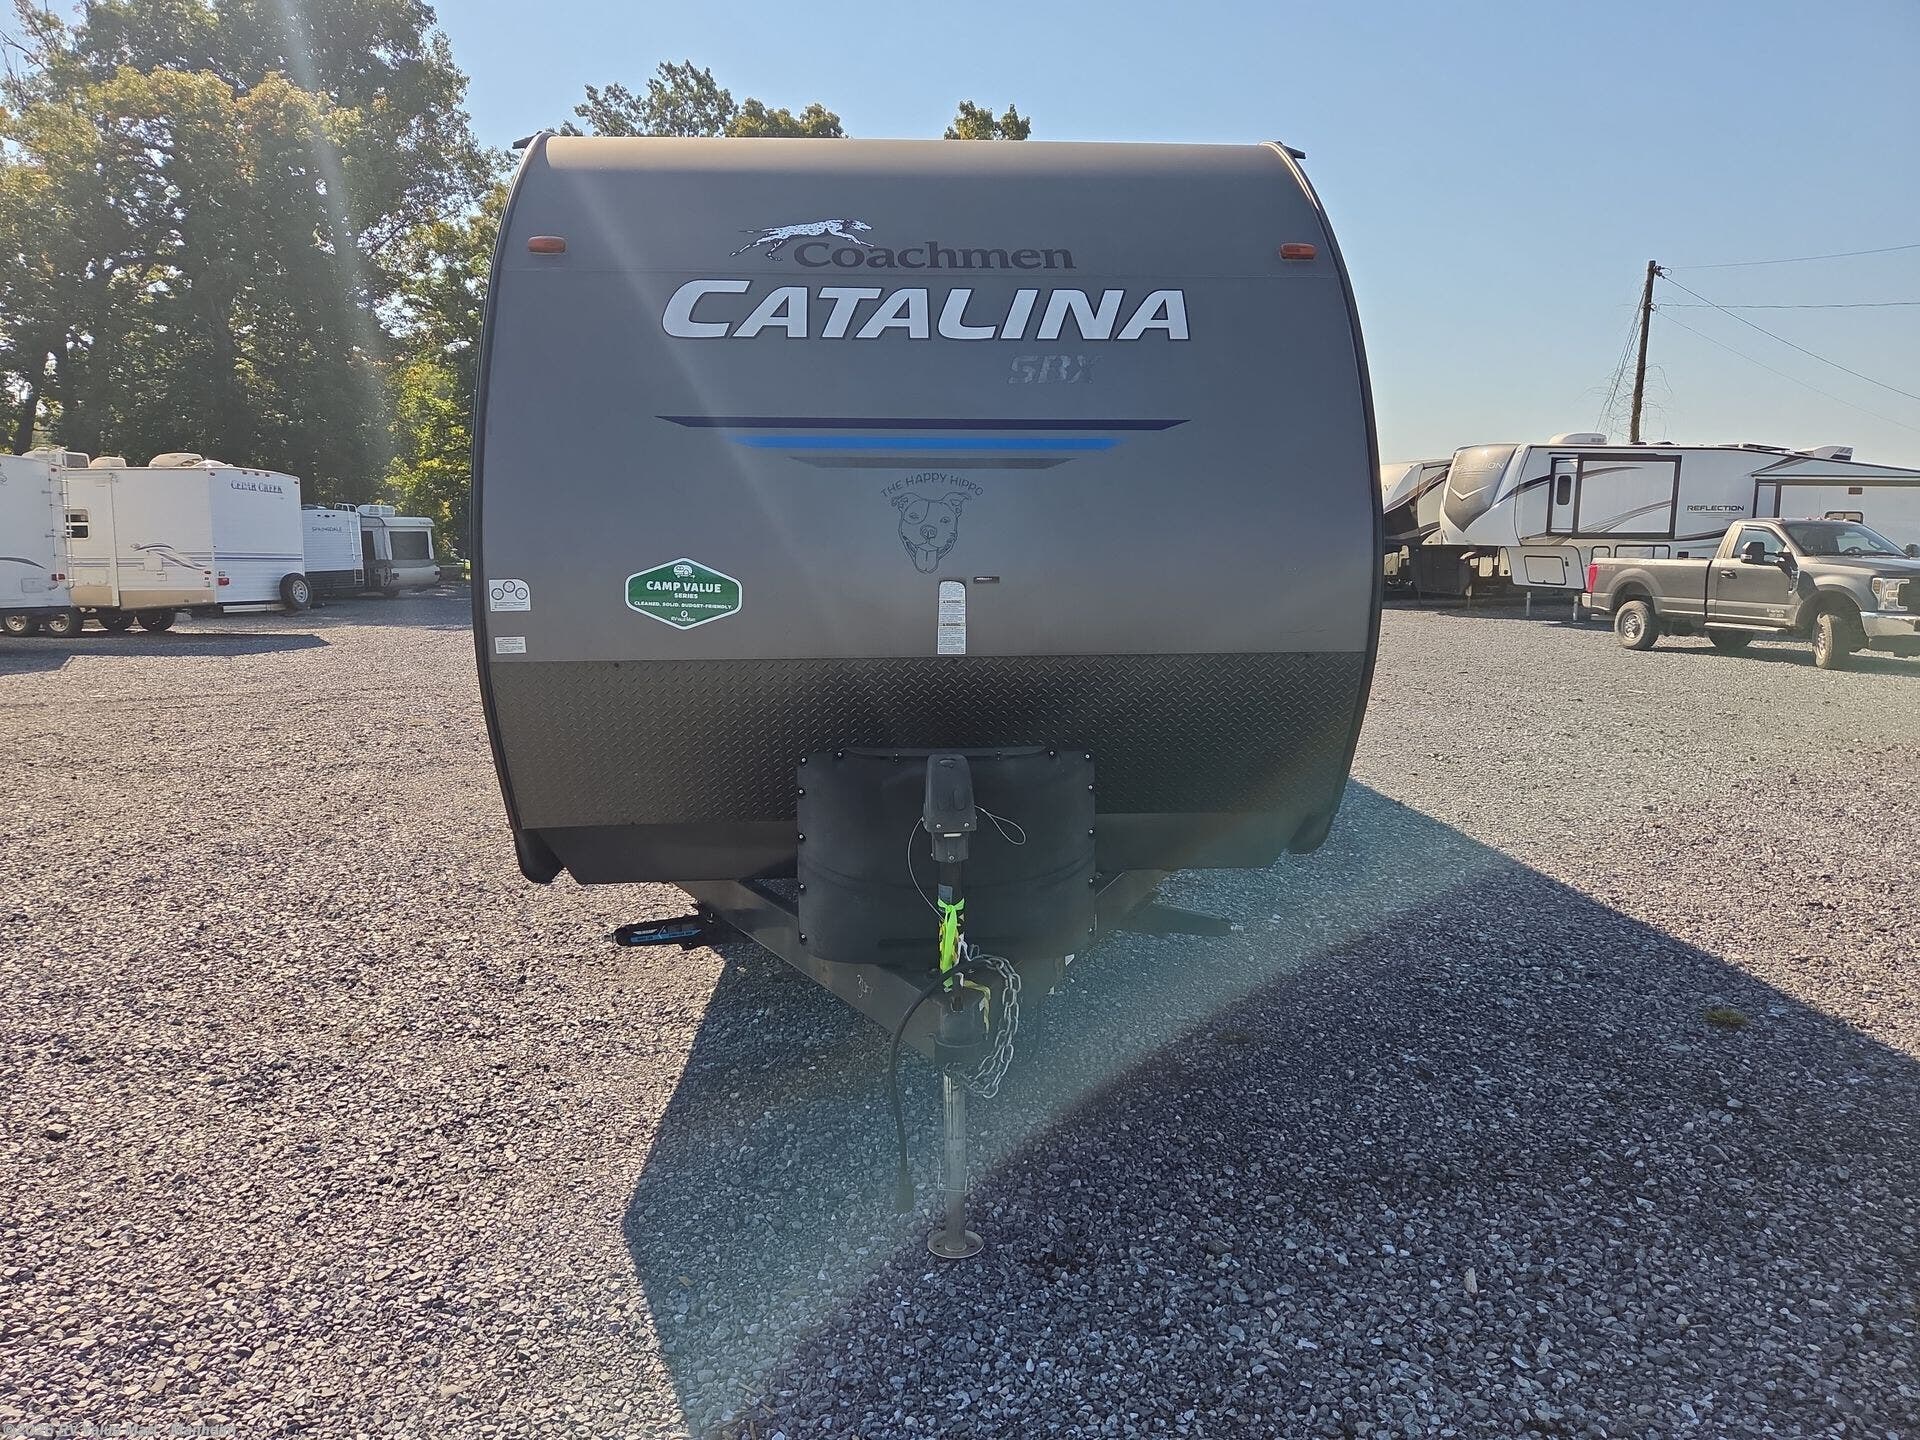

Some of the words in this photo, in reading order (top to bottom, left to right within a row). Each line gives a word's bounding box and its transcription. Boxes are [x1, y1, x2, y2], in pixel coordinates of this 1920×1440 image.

[794, 241, 1077, 269] Coachmen
[661, 278, 1191, 342] CATALINA
[880, 480, 903, 498] THE
[905, 472, 947, 486] HAPPY
[950, 475, 984, 496] HIPPO
[646, 581, 681, 591] CAMP
[683, 582, 722, 593] VALUE
